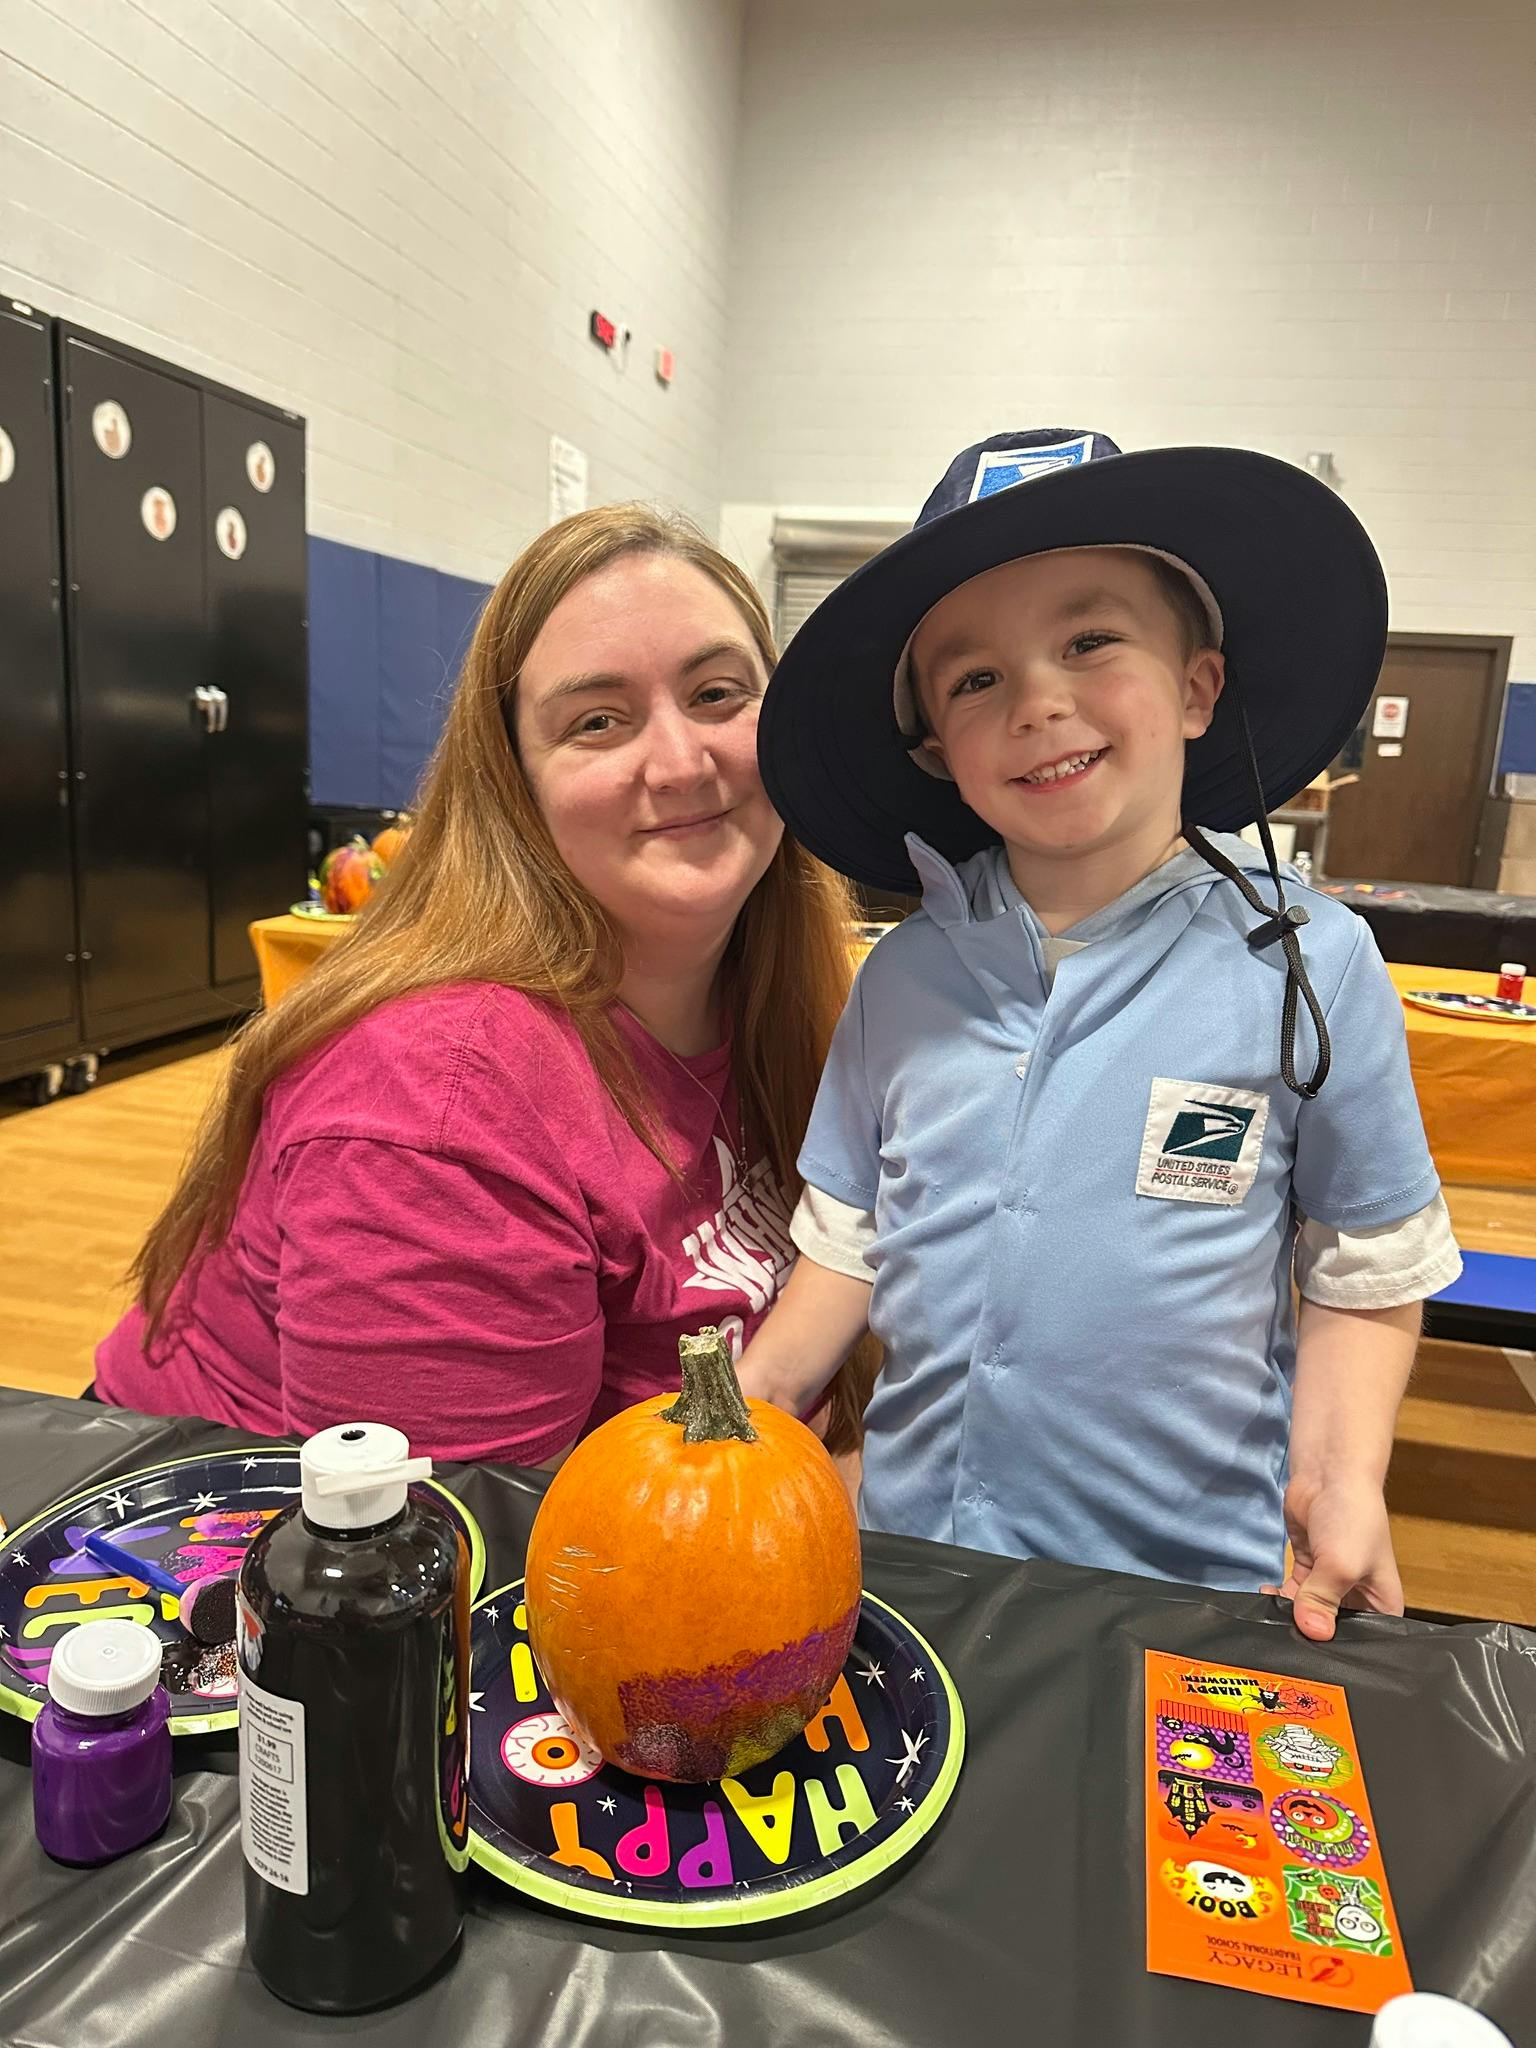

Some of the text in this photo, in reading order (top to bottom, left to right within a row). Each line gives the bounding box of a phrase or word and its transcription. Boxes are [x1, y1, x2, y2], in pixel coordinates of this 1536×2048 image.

[1157, 1158, 1231, 1176] UNITED STATES
[1151, 1172, 1190, 1187] POSTAL
[1179, 1674, 1259, 1687] HALLOWEEN!
[1187, 1684, 1242, 1697] HAPPY
[255, 1743, 280, 1763] CRAFTS
[549, 1764, 878, 1888] HAPPY
[1187, 1891, 1258, 1918] BOO!
[1206, 1935, 1301, 1961] TRADITIONAL SCHOOL
[1208, 1951, 1302, 1978] LEGACY
